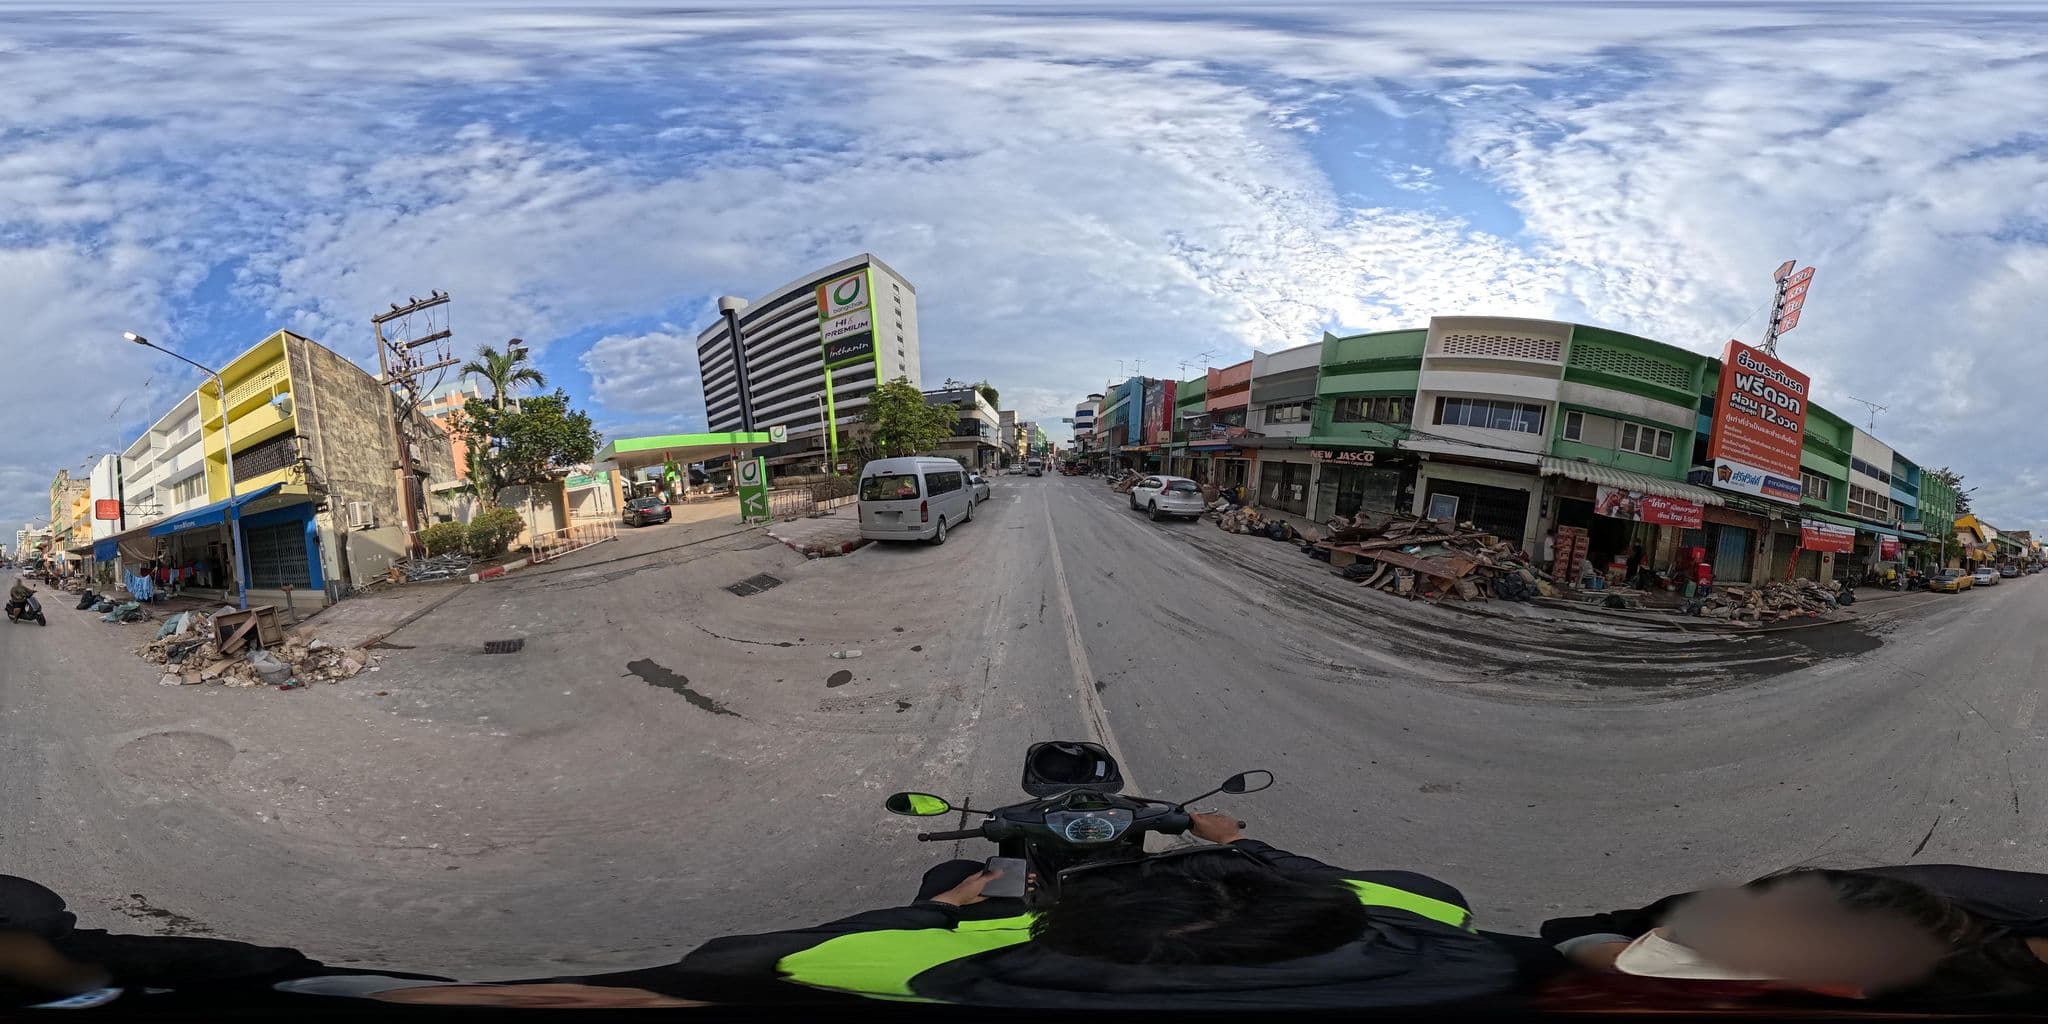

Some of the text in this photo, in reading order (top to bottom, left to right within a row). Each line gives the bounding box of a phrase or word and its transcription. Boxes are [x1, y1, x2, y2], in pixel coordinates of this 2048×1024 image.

[824, 320, 868, 339] PREMIUM
[1739, 351, 1803, 394] ซื้อประกันรถ
[1732, 392, 1799, 433] ผ่อน 12 งวด
[1736, 373, 1800, 414] ฟรีดอก
[1311, 450, 1333, 459] NEW
[1337, 451, 1375, 461] JASCO
